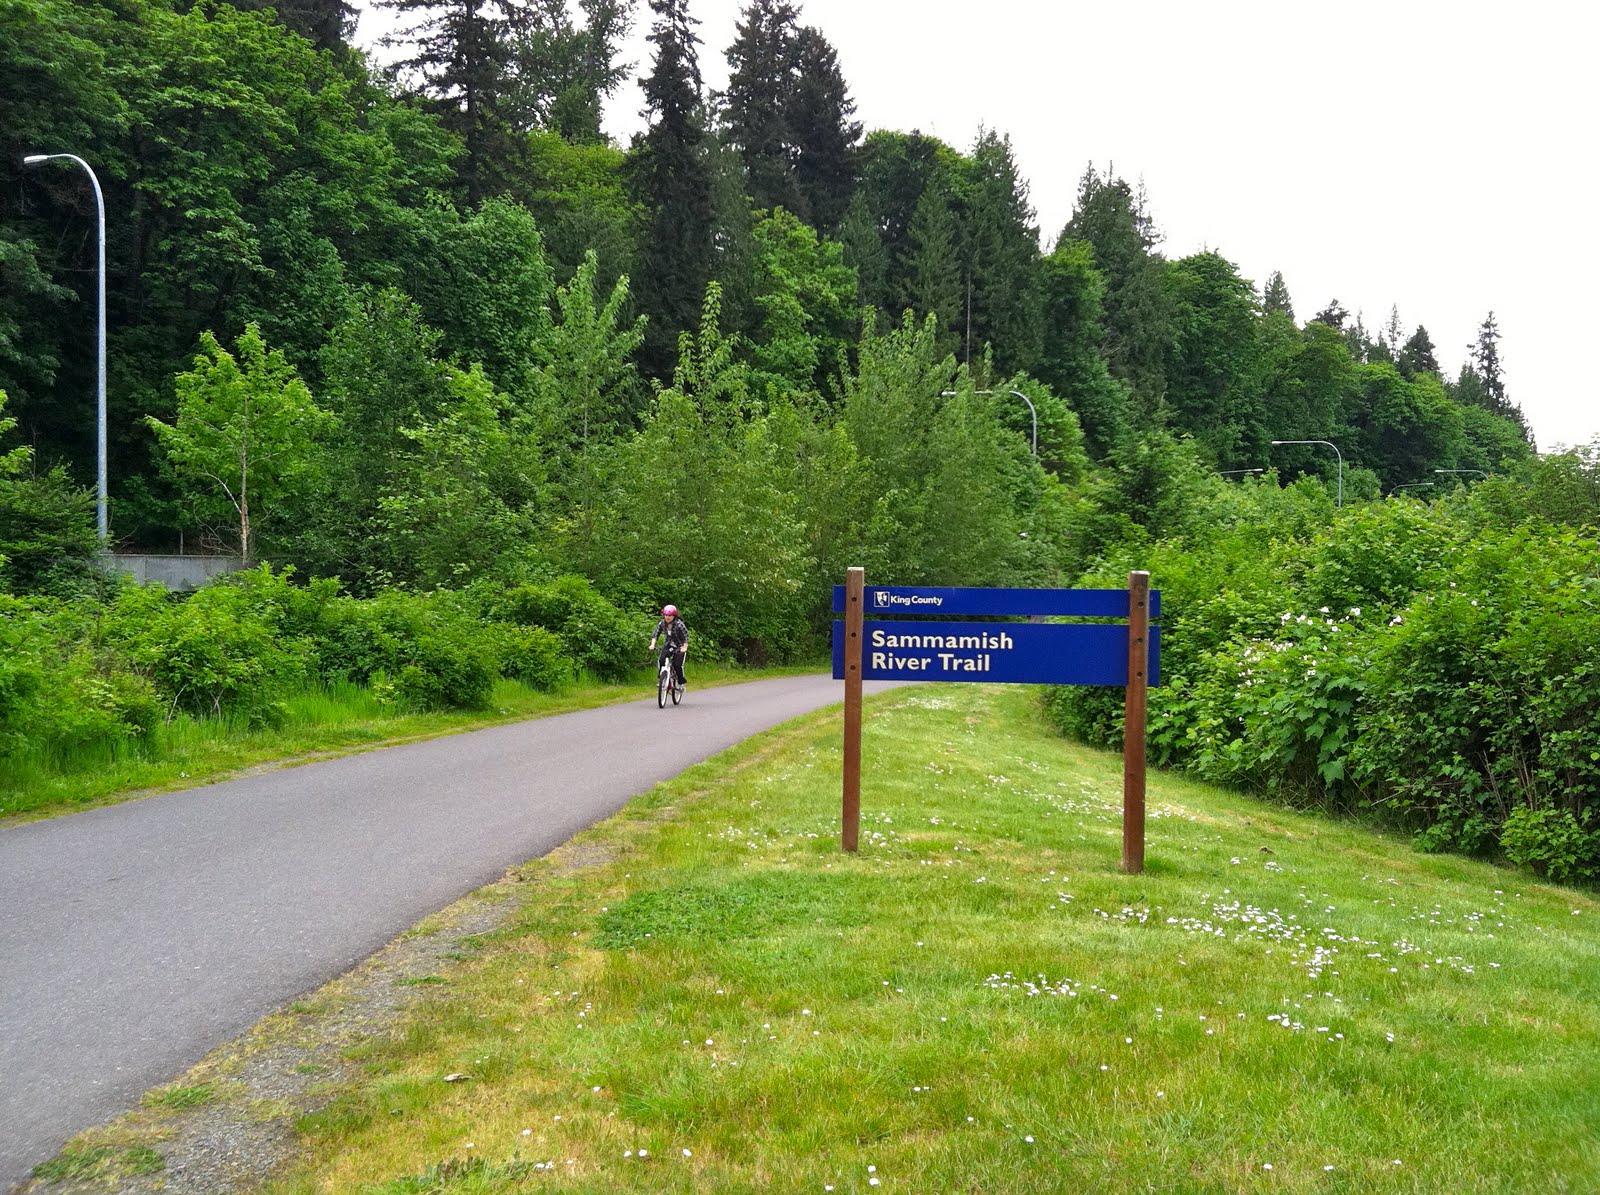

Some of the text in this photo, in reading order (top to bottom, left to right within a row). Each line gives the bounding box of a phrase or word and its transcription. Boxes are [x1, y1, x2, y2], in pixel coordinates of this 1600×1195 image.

[890, 595, 943, 606] King County
[871, 630, 1013, 649] Sammamish
[871, 652, 990, 671] River Trail
